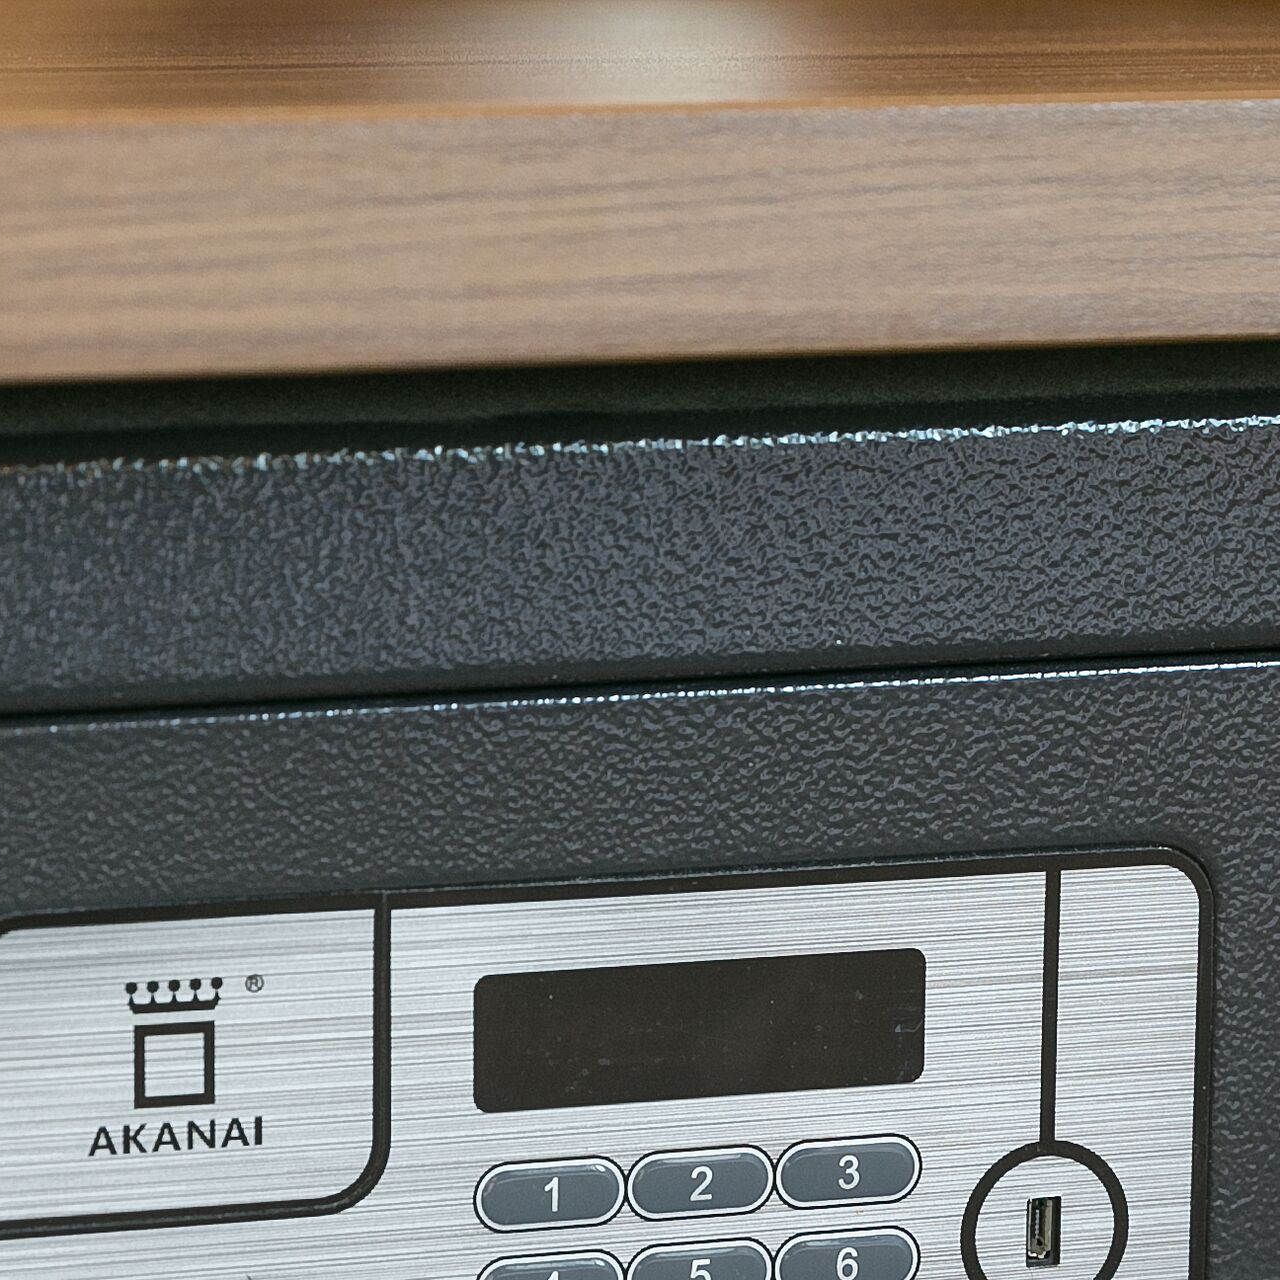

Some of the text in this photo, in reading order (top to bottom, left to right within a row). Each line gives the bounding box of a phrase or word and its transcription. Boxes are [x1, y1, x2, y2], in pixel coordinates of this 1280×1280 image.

[88, 1116, 262, 1157] AKANAI
[545, 1155, 859, 1211] 1 2 3
[837, 1247, 858, 1280] 6
